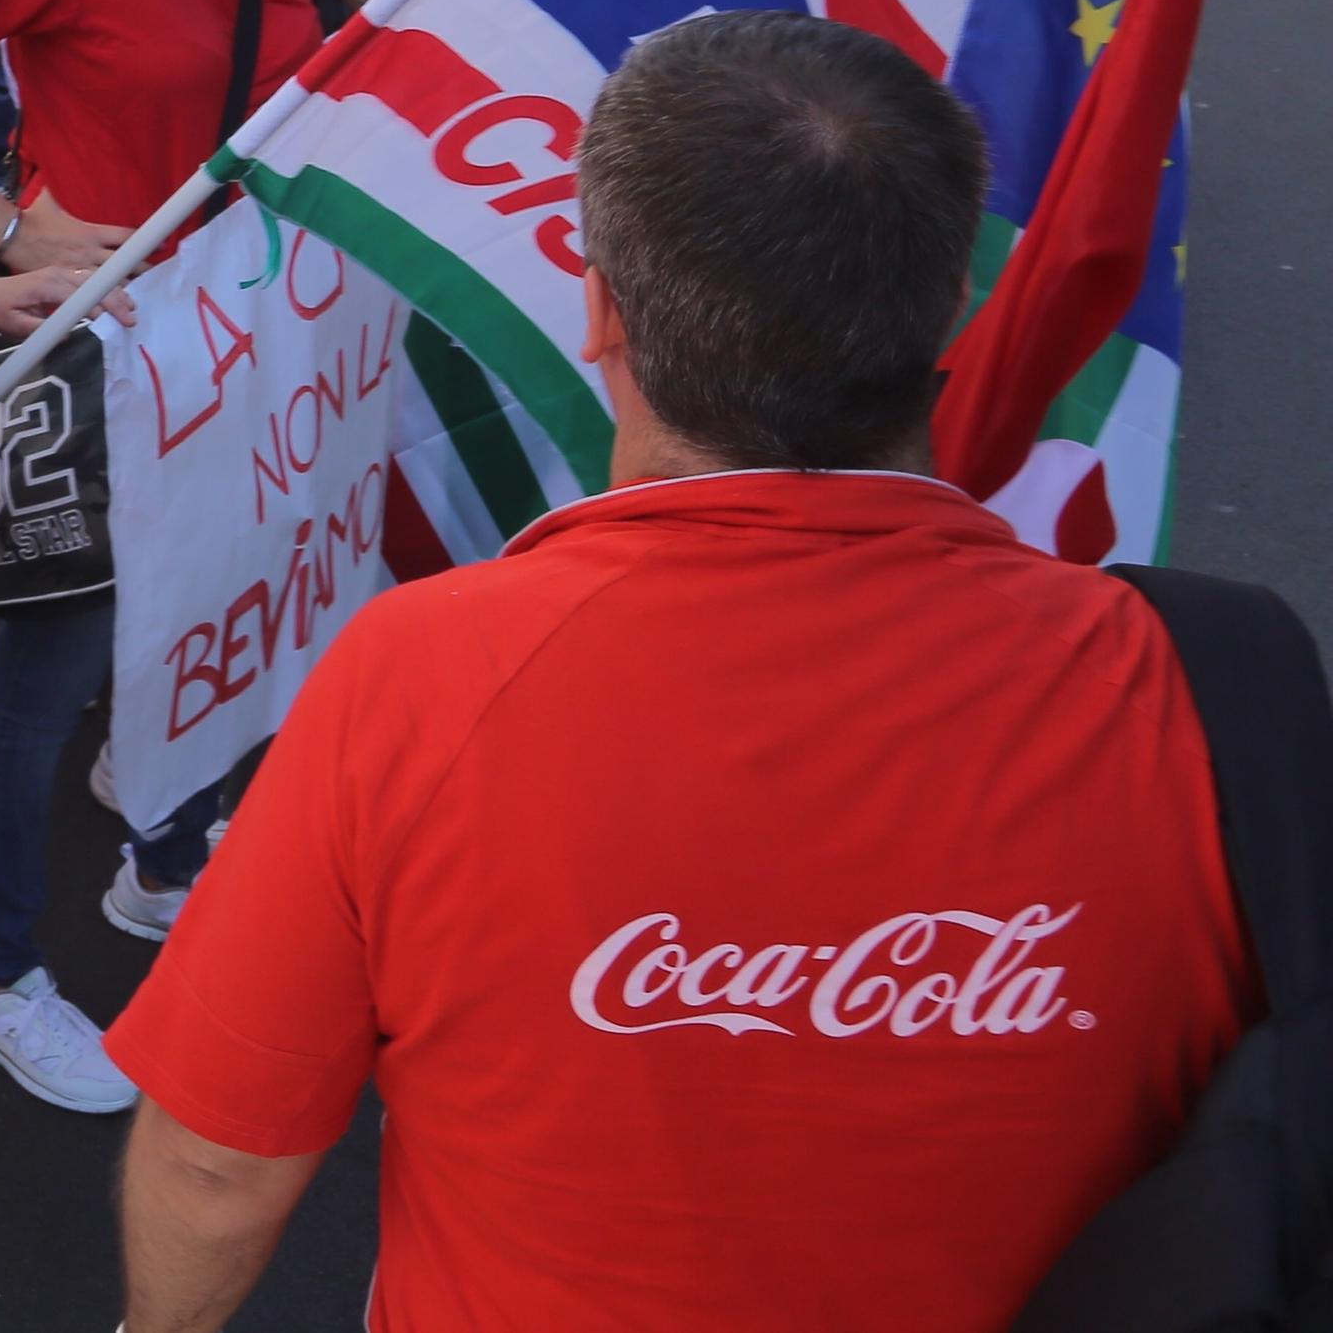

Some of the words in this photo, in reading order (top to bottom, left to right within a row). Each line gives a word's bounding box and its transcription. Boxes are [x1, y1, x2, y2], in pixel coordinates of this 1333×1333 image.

[139, 285, 257, 460] LA
[251, 348, 346, 525] NON
[10, 509, 93, 561] STAR
[569, 902, 1084, 1038] Coca-Cola
